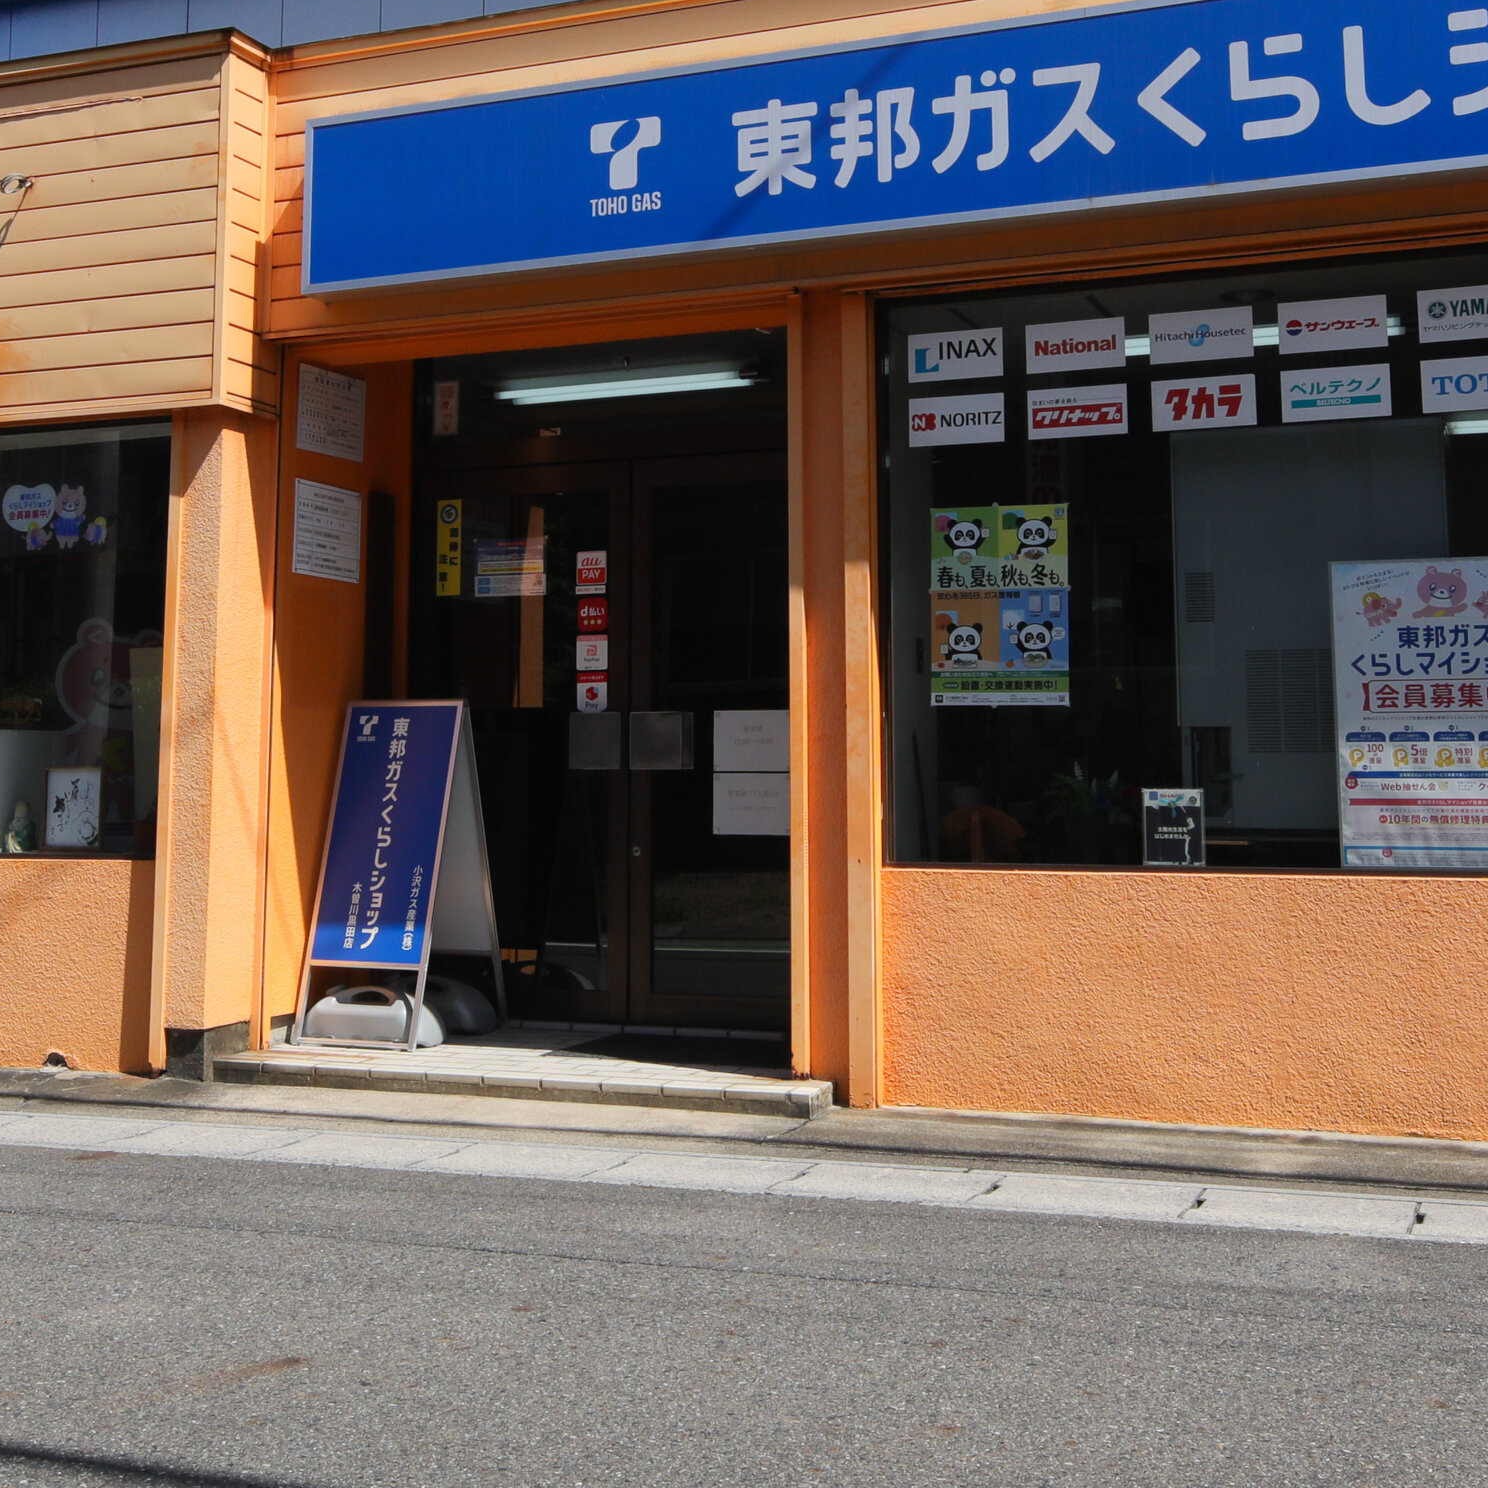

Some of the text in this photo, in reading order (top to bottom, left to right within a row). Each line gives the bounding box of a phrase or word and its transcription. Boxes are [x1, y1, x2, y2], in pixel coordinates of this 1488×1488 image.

[590, 191, 662, 217] TOHO GAS
[938, 337, 999, 361] INAX
[1033, 334, 1117, 357] National
[1289, 376, 1382, 396] ベルテクノ
[1163, 383, 1244, 422] タカラ
[940, 410, 1003, 428] NORITZ
[582, 569, 601, 579] PAY
[580, 605, 605, 617] d払い
[585, 700, 599, 711] Pay
[1366, 743, 1384, 753] 100
[1410, 744, 1428, 757] 5倍
[1455, 747, 1473, 757] 特別
[1380, 782, 1437, 792] Web抽せん会
[359, 717, 411, 950] 東邦ガスくらしショップ
[342, 881, 363, 949] 木曽川黒田店
